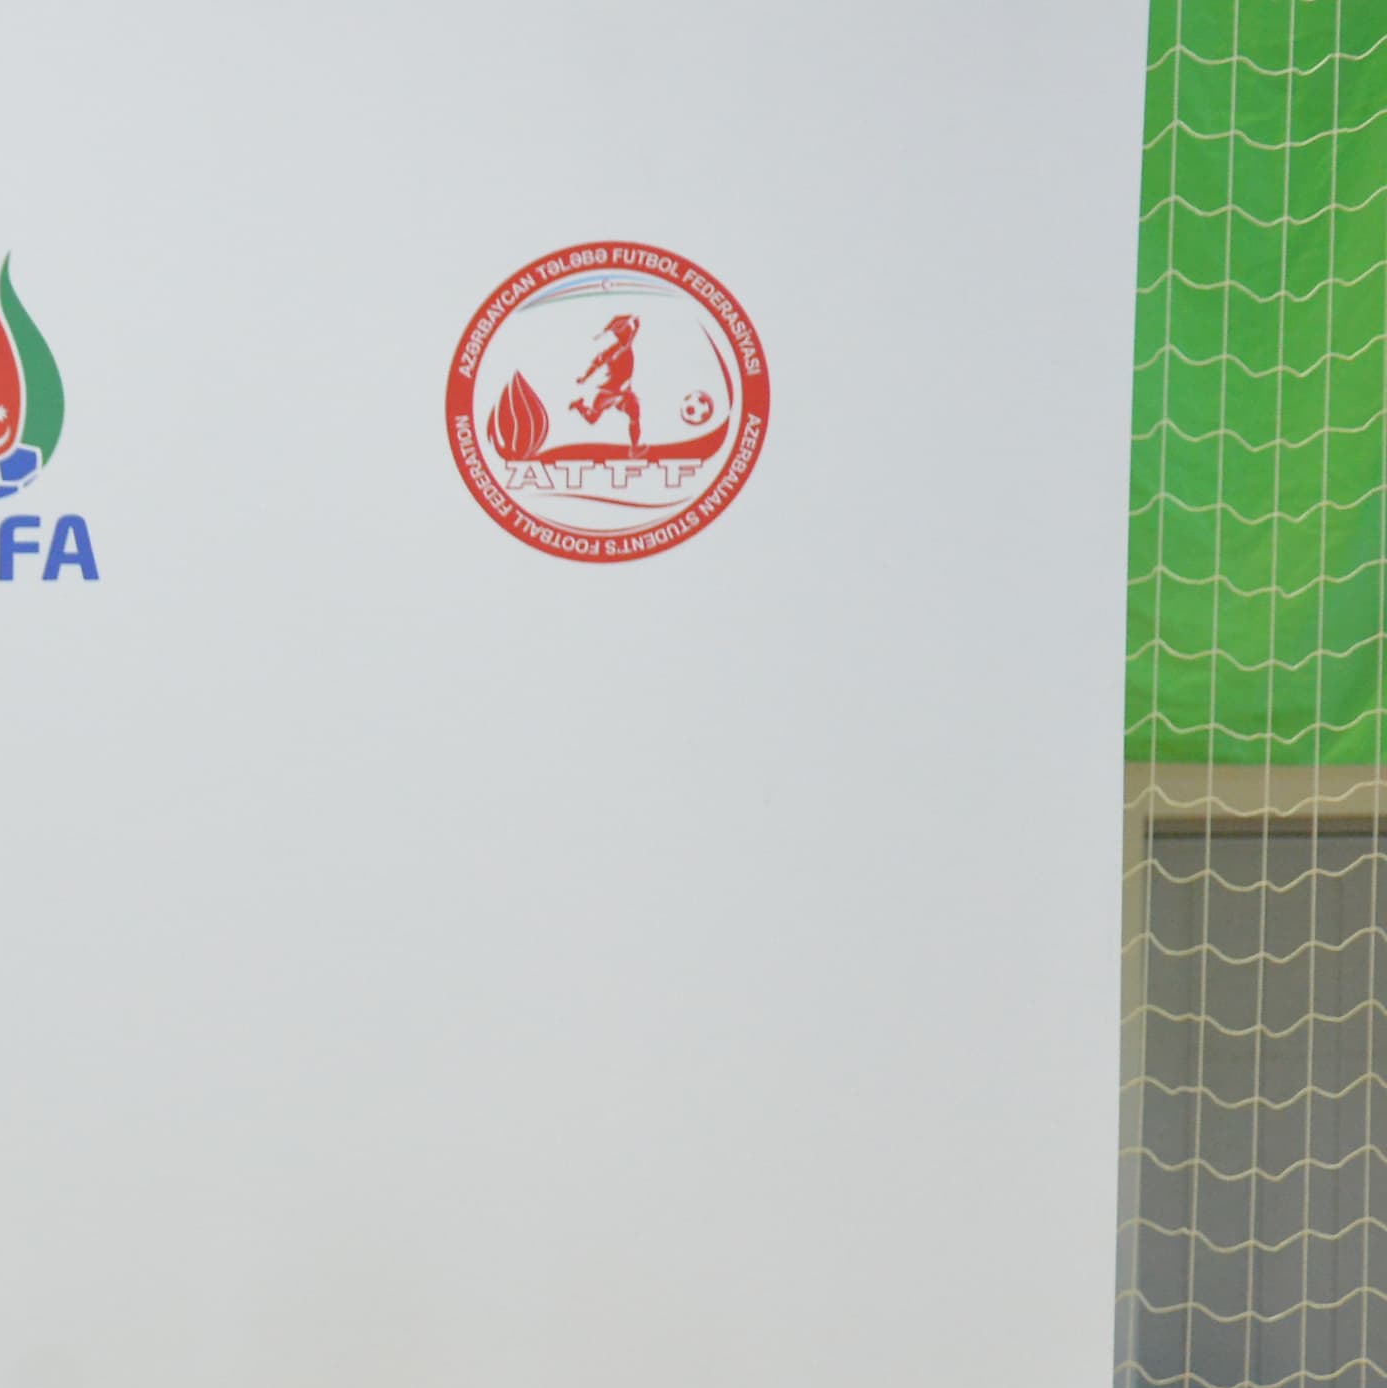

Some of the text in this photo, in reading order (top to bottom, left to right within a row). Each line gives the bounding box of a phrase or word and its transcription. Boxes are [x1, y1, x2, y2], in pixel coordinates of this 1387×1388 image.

[458, 246, 762, 379] AZƏRBAYCAN TƏLƏBƏ FUTBOL FEDERASİYASI
[454, 412, 762, 556] AZERBAIJAN STUDENT'S FOOTBALL FEDERATION
[504, 457, 703, 491] ATFF
